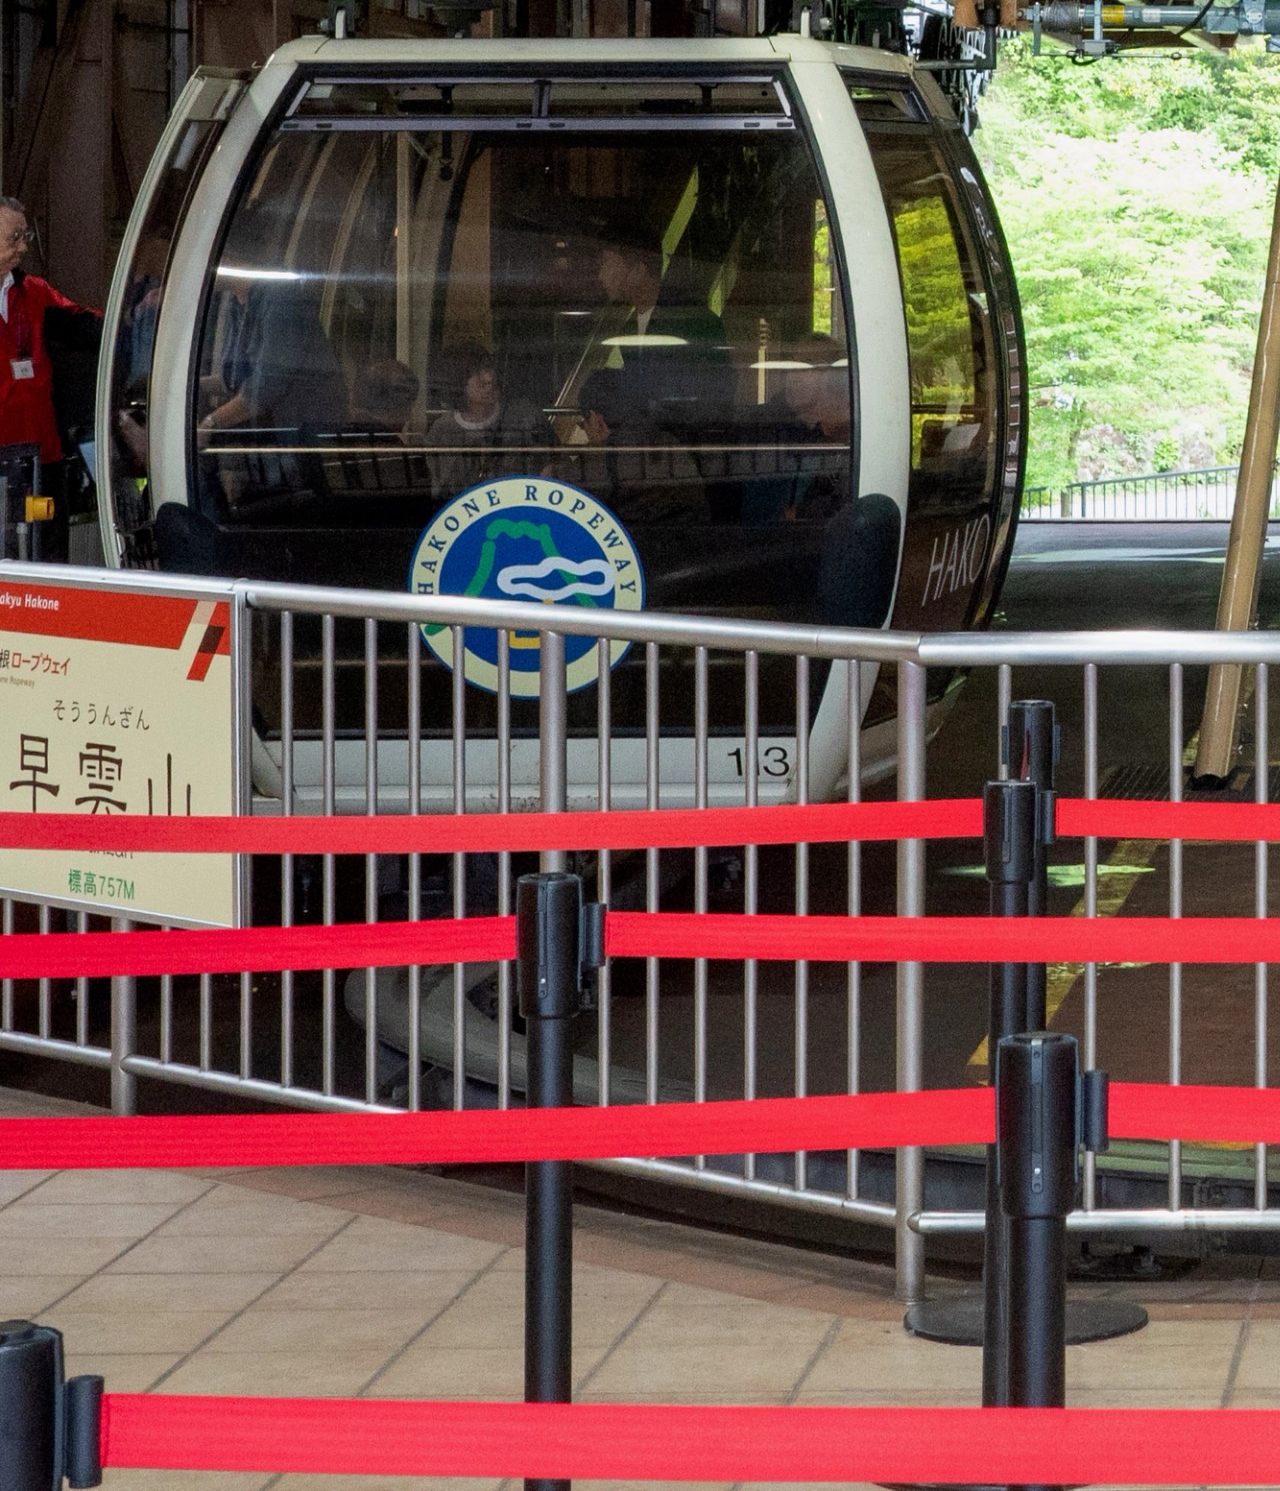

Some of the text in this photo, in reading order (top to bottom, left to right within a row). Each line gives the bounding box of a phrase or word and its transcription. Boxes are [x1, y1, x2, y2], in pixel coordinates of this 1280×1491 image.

[417, 484, 637, 595] HAKONE ROPEWAY
[25, 594, 60, 611] Hakone
[53, 699, 150, 731] そううんざん
[9, 733, 191, 816] 早雲山
[68, 869, 135, 901] 標高757M
